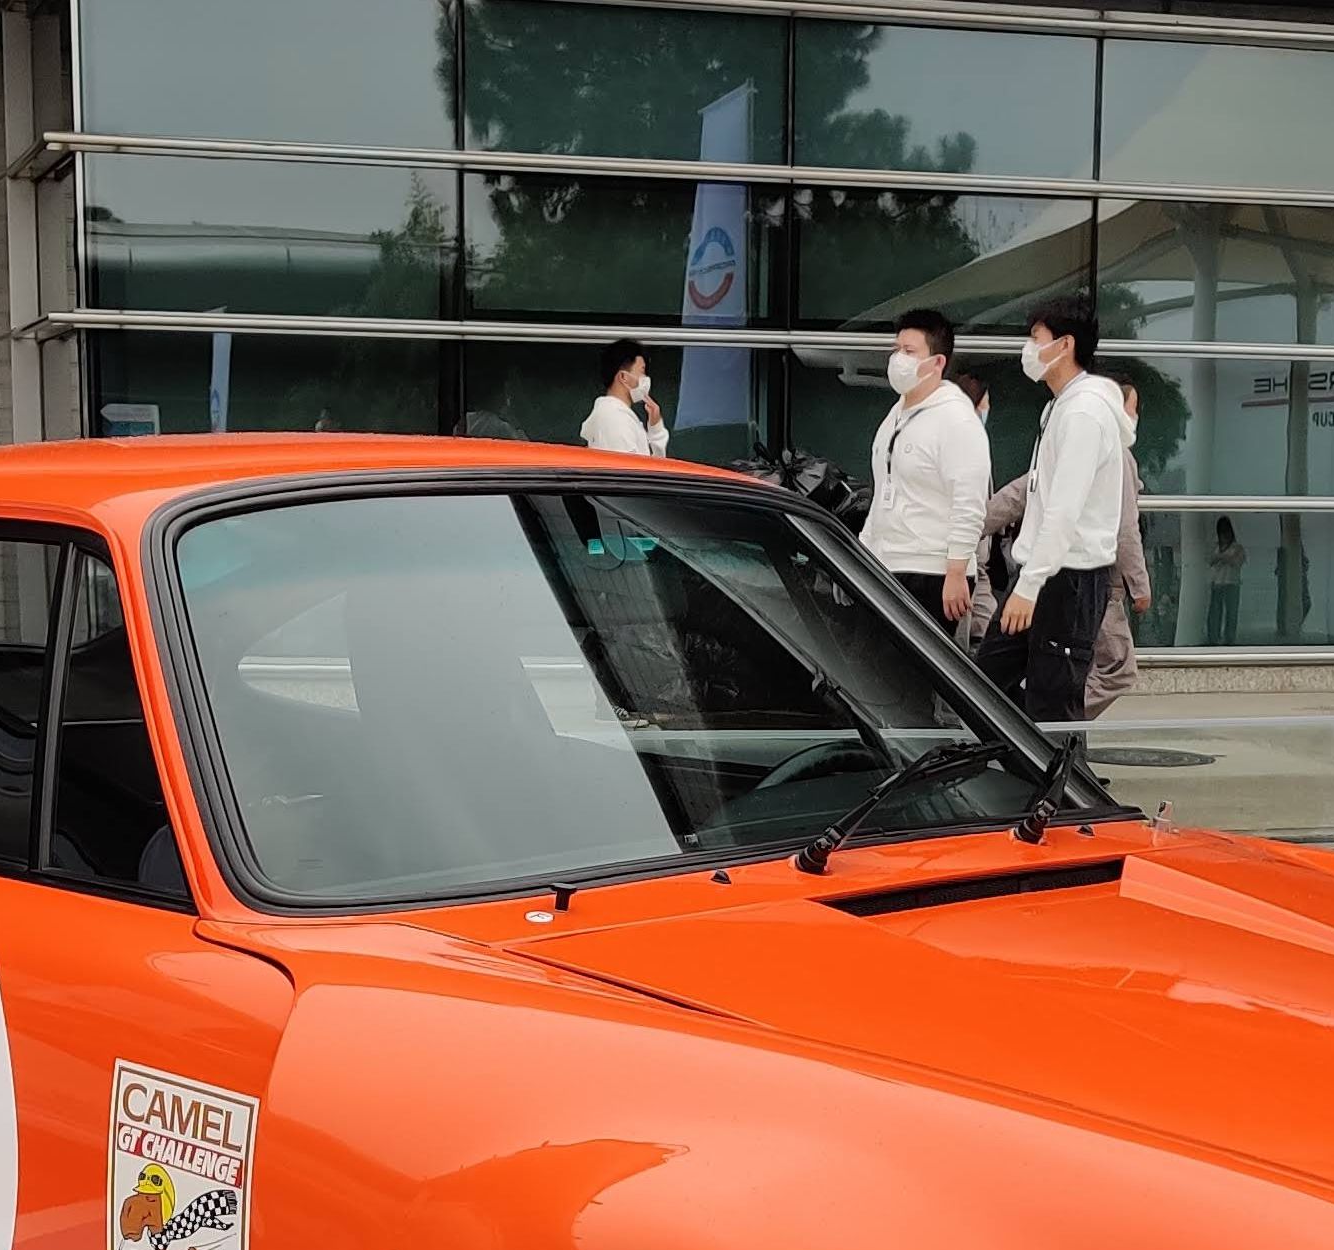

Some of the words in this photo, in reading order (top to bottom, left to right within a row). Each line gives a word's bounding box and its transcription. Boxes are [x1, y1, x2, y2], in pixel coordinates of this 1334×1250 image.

[123, 1082, 243, 1153] CAMEL
[118, 1125, 143, 1153] GT
[141, 1131, 241, 1185] CHALLENGE
